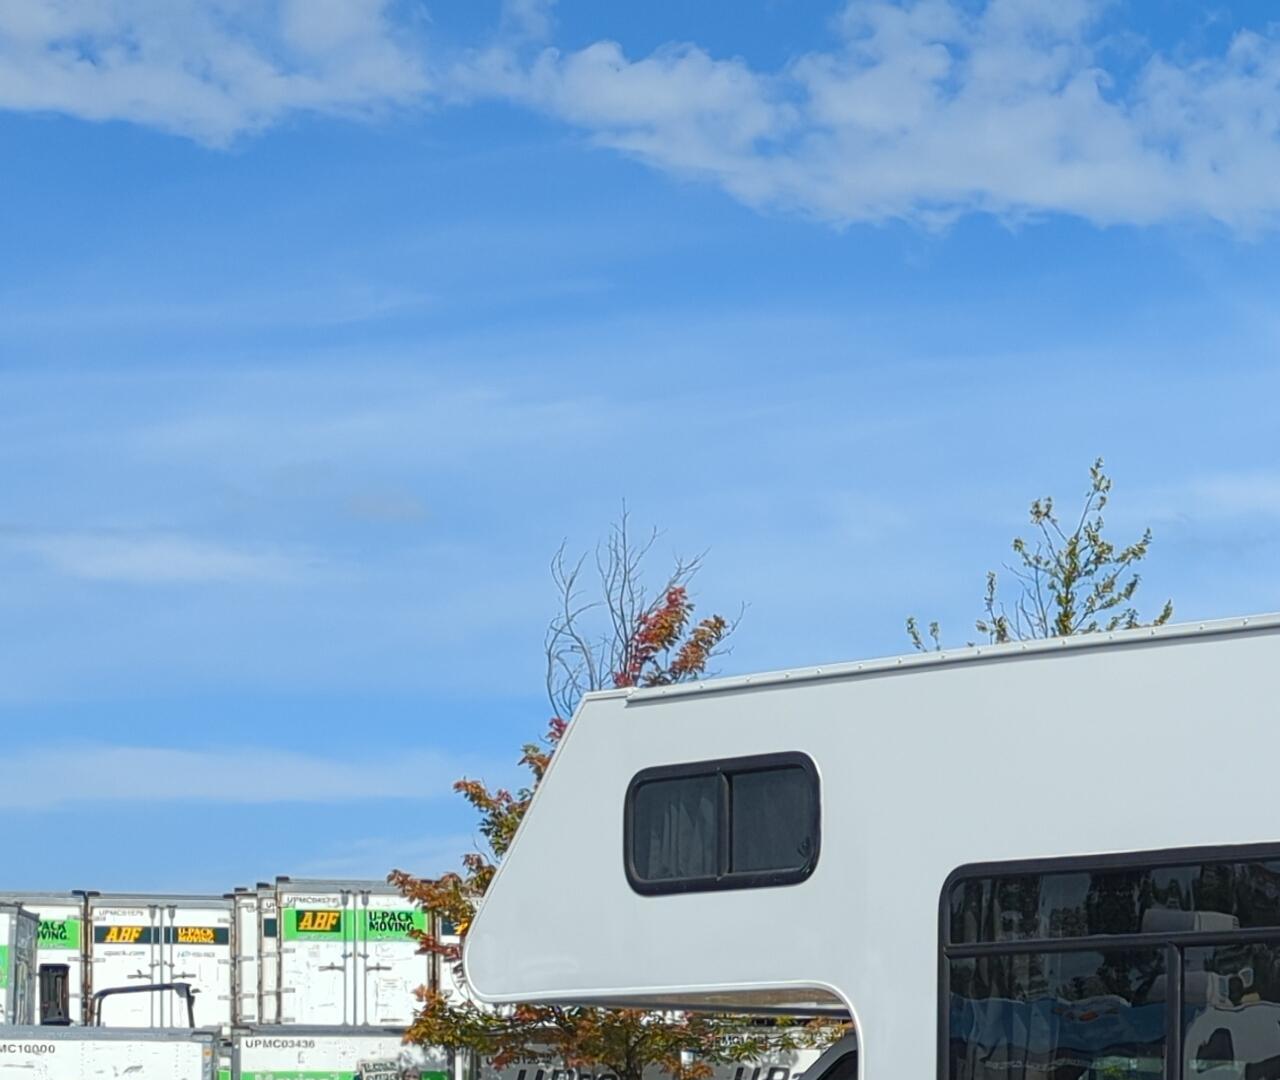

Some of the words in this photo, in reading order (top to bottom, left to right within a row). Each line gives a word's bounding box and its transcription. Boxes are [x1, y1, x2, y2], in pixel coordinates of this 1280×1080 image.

[299, 911, 340, 931] ABF
[368, 911, 414, 922] U-PACK
[368, 921, 415, 932] MOVING
[104, 926, 144, 943] ABF
